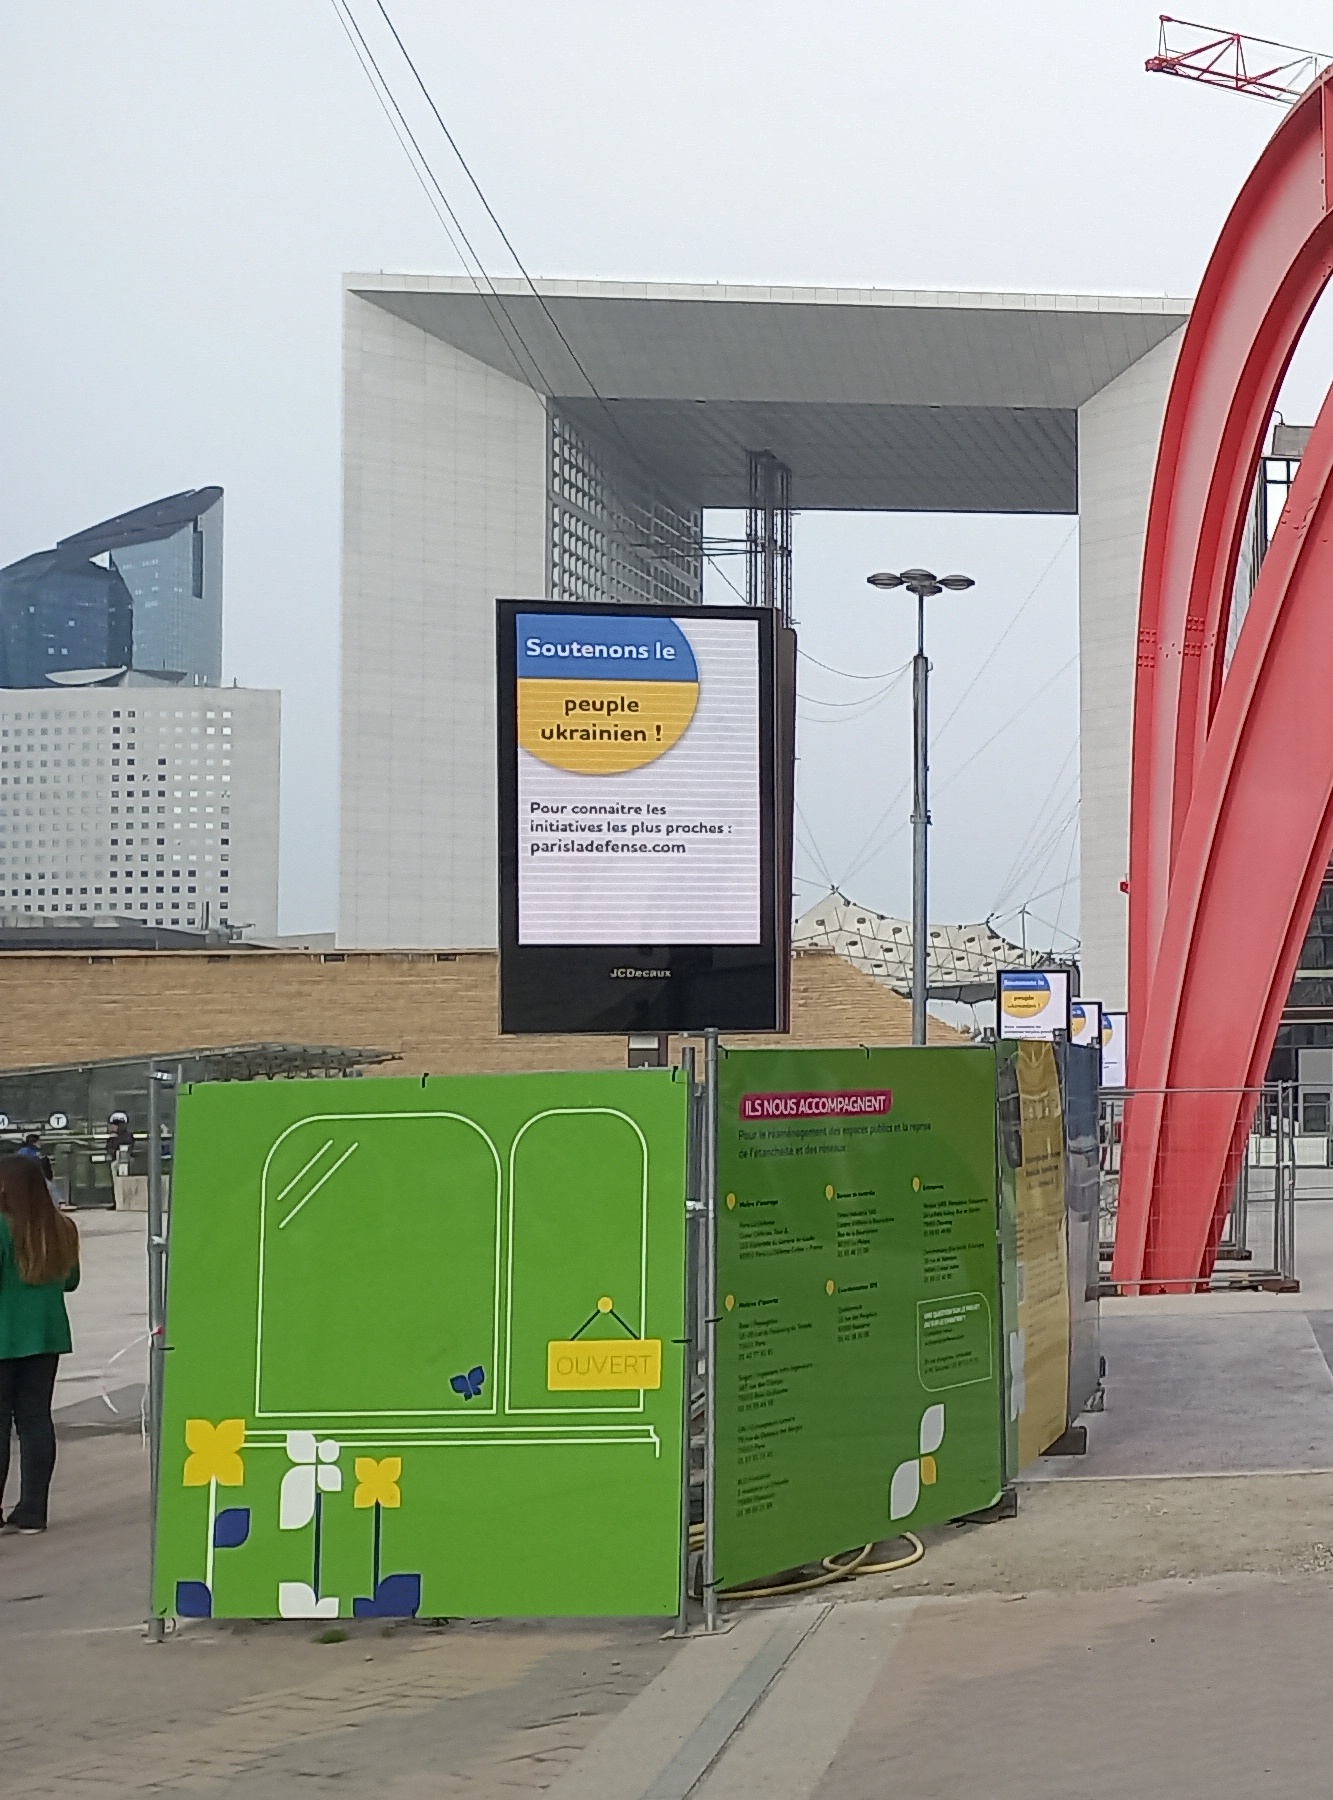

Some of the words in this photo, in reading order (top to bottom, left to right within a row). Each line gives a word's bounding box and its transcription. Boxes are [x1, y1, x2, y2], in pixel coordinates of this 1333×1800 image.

[525, 638, 649, 660] Soutenons
[655, 641, 676, 660] le
[564, 695, 640, 717] peuple
[541, 723, 647, 742] ukrainien
[655, 724, 662, 742] !
[530, 802, 568, 815] Pour
[646, 804, 667, 815] les
[530, 820, 603, 833] initiatives
[607, 820, 628, 833] les
[631, 821, 662, 836] plus
[665, 822, 724, 836] proches
[530, 838, 687, 856] parisladefense.com
[609, 968, 672, 978] JCDecaux
[745, 1100, 762, 1116] ILS
[764, 1098, 797, 1116] NOUS
[798, 1096, 886, 1114] ACCOMPAGNENT
[556, 1354, 653, 1375] OUVERT
